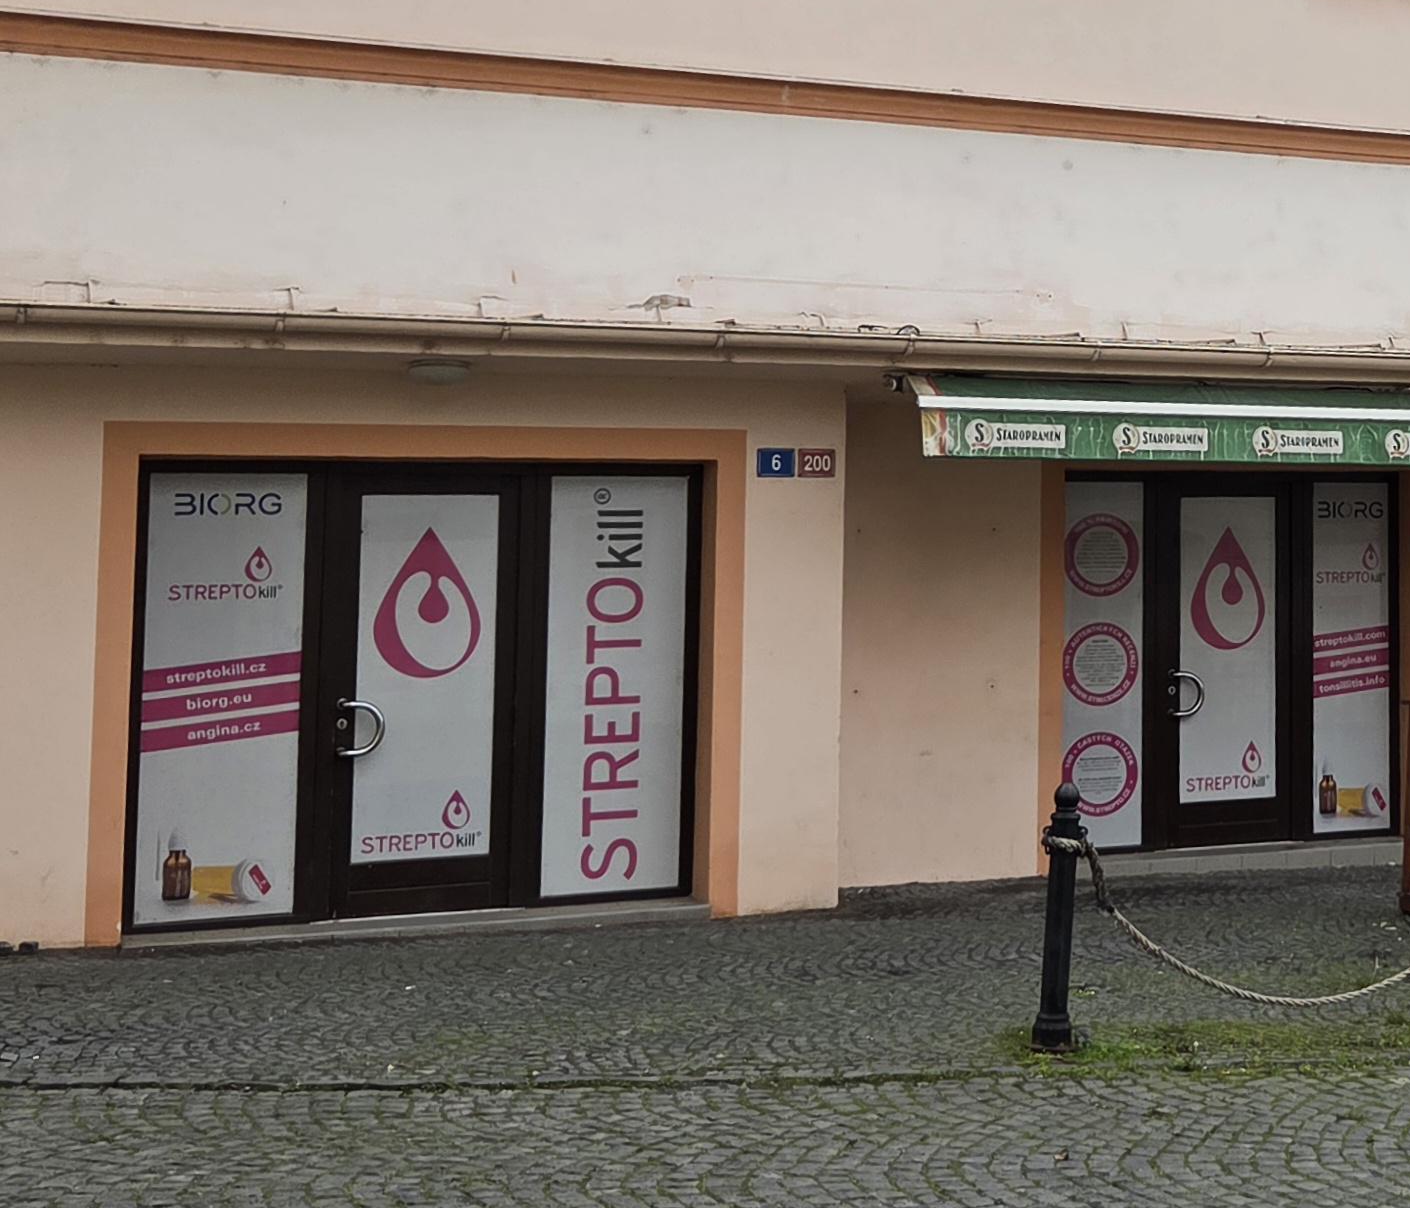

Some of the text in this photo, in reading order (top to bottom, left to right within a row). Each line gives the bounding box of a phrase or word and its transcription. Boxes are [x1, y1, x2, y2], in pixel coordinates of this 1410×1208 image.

[975, 423, 984, 442] S
[996, 427, 1062, 442] STAROPRAMEN
[1122, 427, 1131, 445] S
[1142, 431, 1204, 444] STAROPRAMEN
[1261, 430, 1270, 449] S
[1280, 434, 1339, 448] STAROPRAMEN
[1393, 433, 1400, 451] S
[771, 454, 781, 471] 6
[804, 455, 831, 471] 200
[174, 492, 282, 516] BIORG
[1317, 501, 1384, 519] BIORG
[1329, 654, 1377, 668] angina.eu
[166, 662, 267, 684] streptokill.cz
[186, 693, 253, 710] biorg.eu
[187, 721, 261, 741] angina.cz
